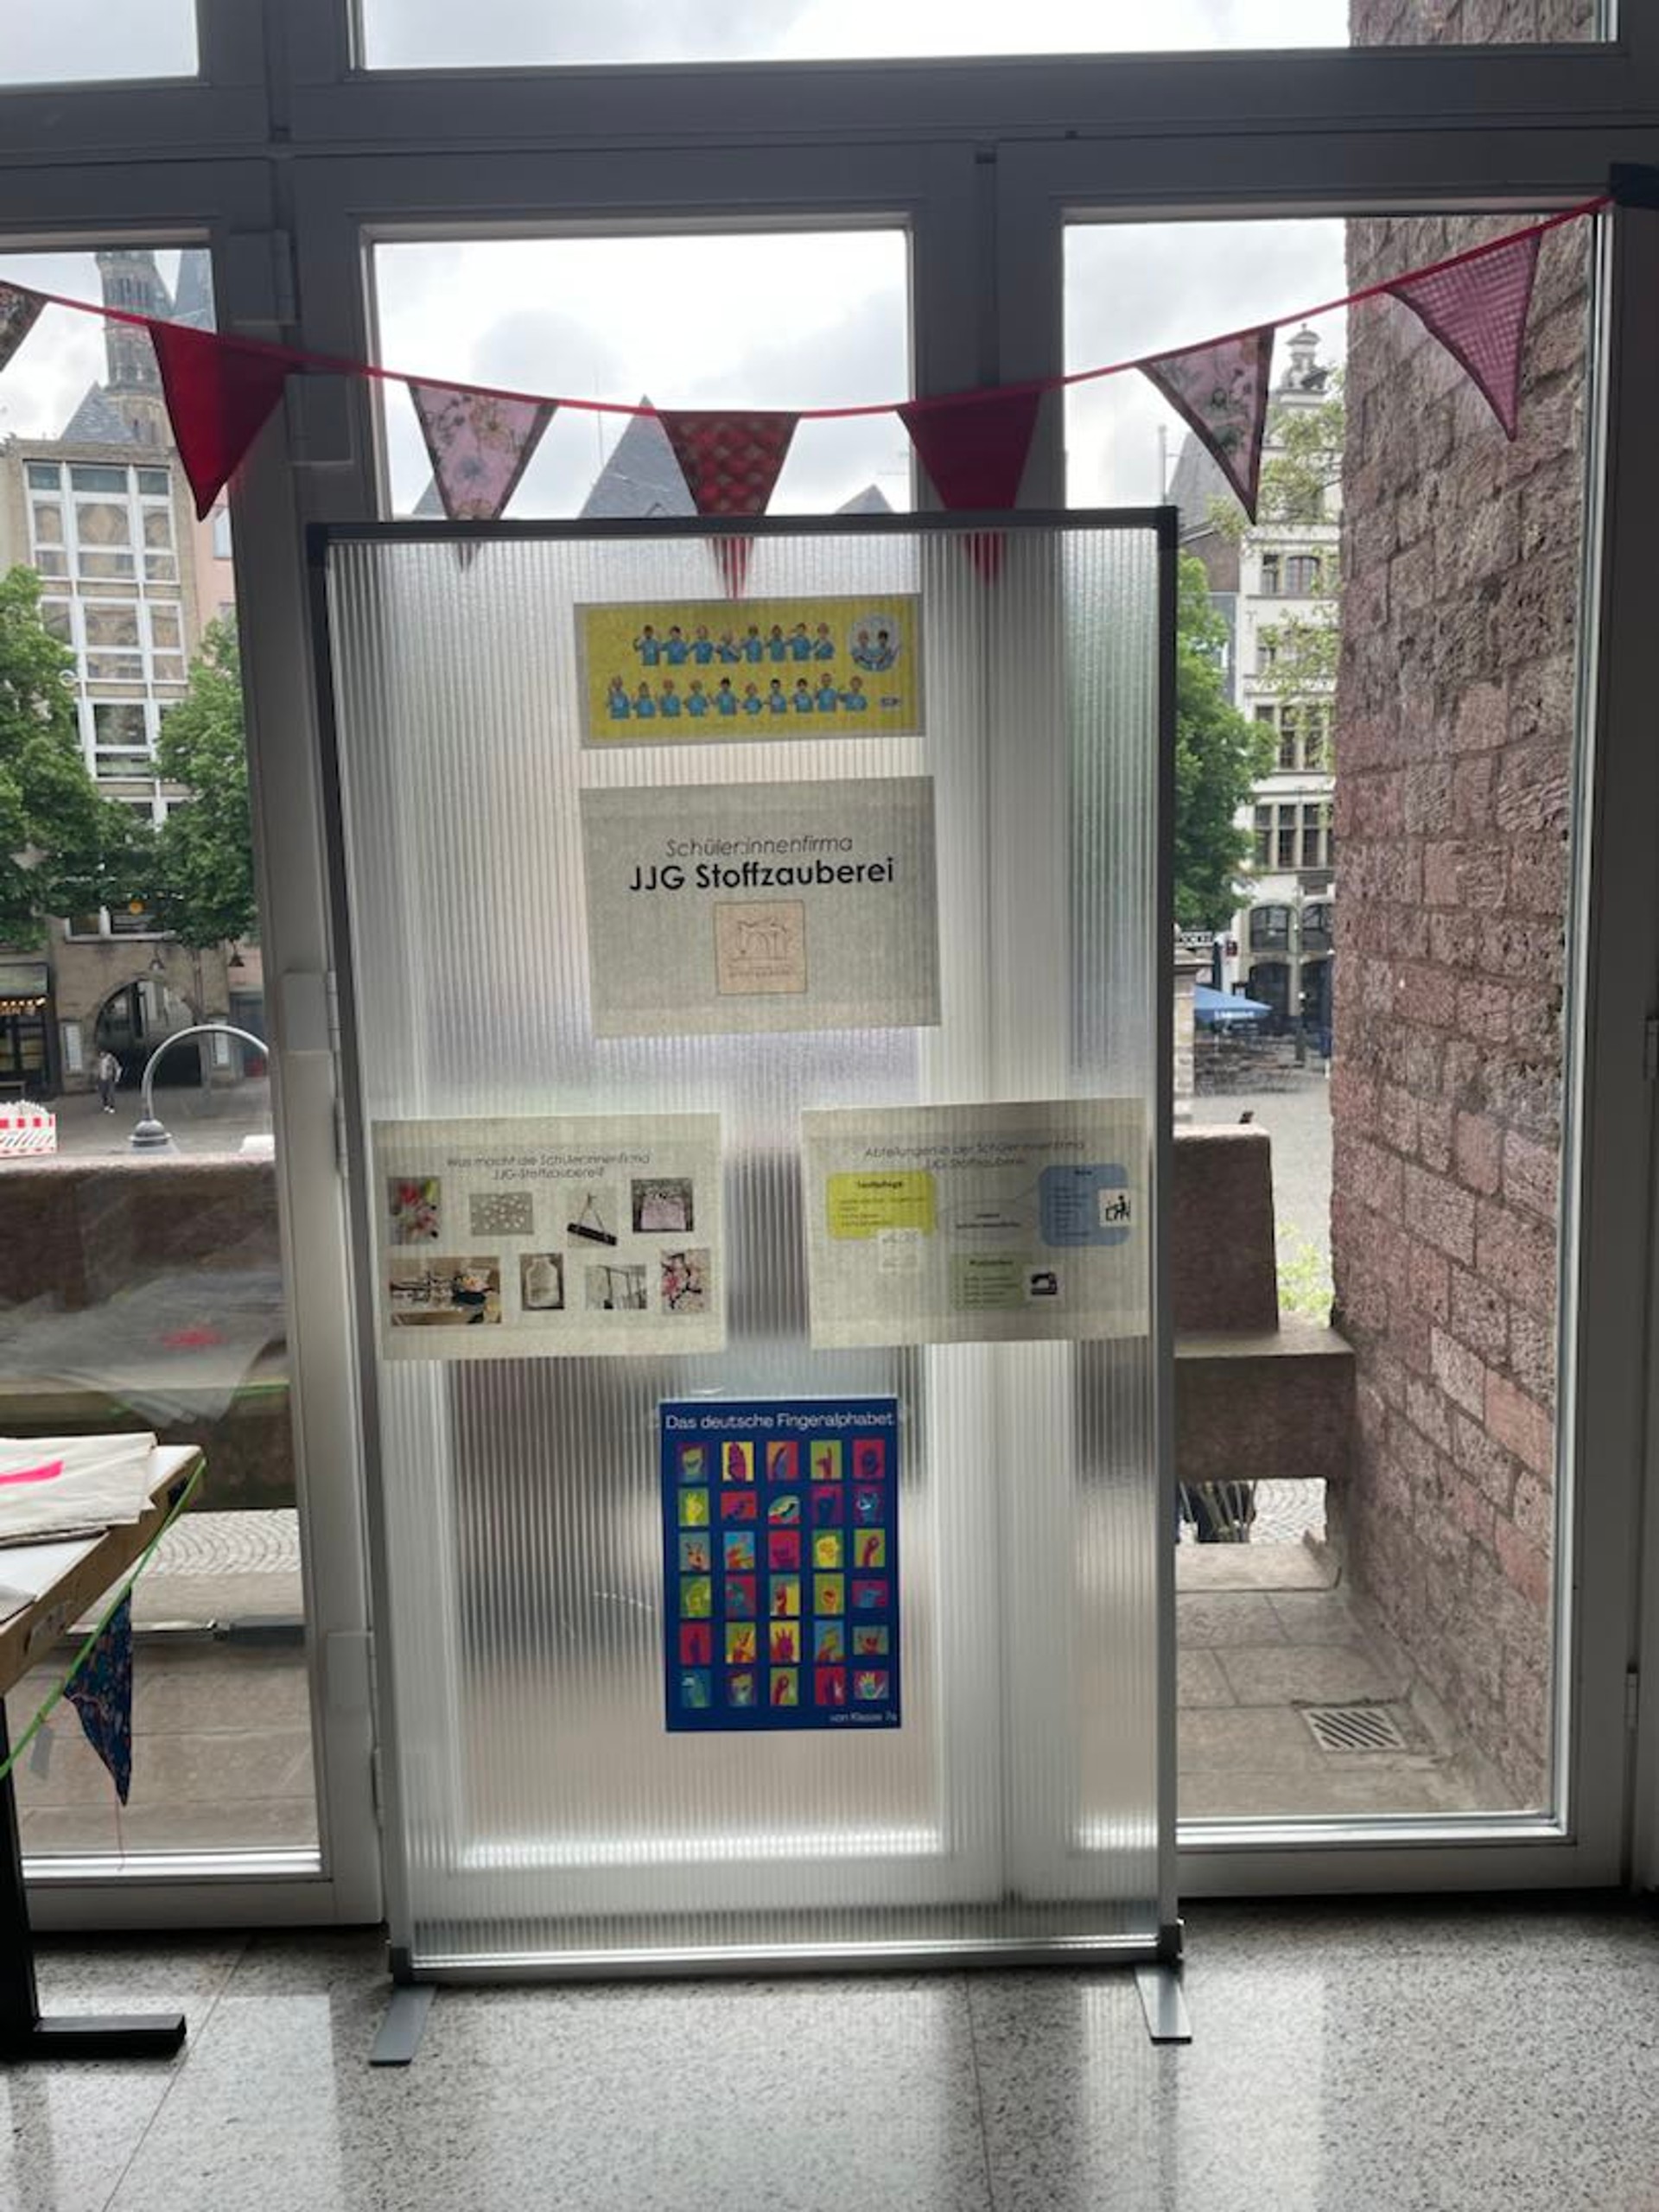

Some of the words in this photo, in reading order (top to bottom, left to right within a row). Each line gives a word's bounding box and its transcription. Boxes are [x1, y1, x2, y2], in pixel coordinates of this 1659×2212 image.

[629, 865, 685, 891] JJG
[696, 857, 895, 888] Stoffzauberei
[664, 1414, 697, 1429] Das
[700, 1413, 774, 1429] deutsche
